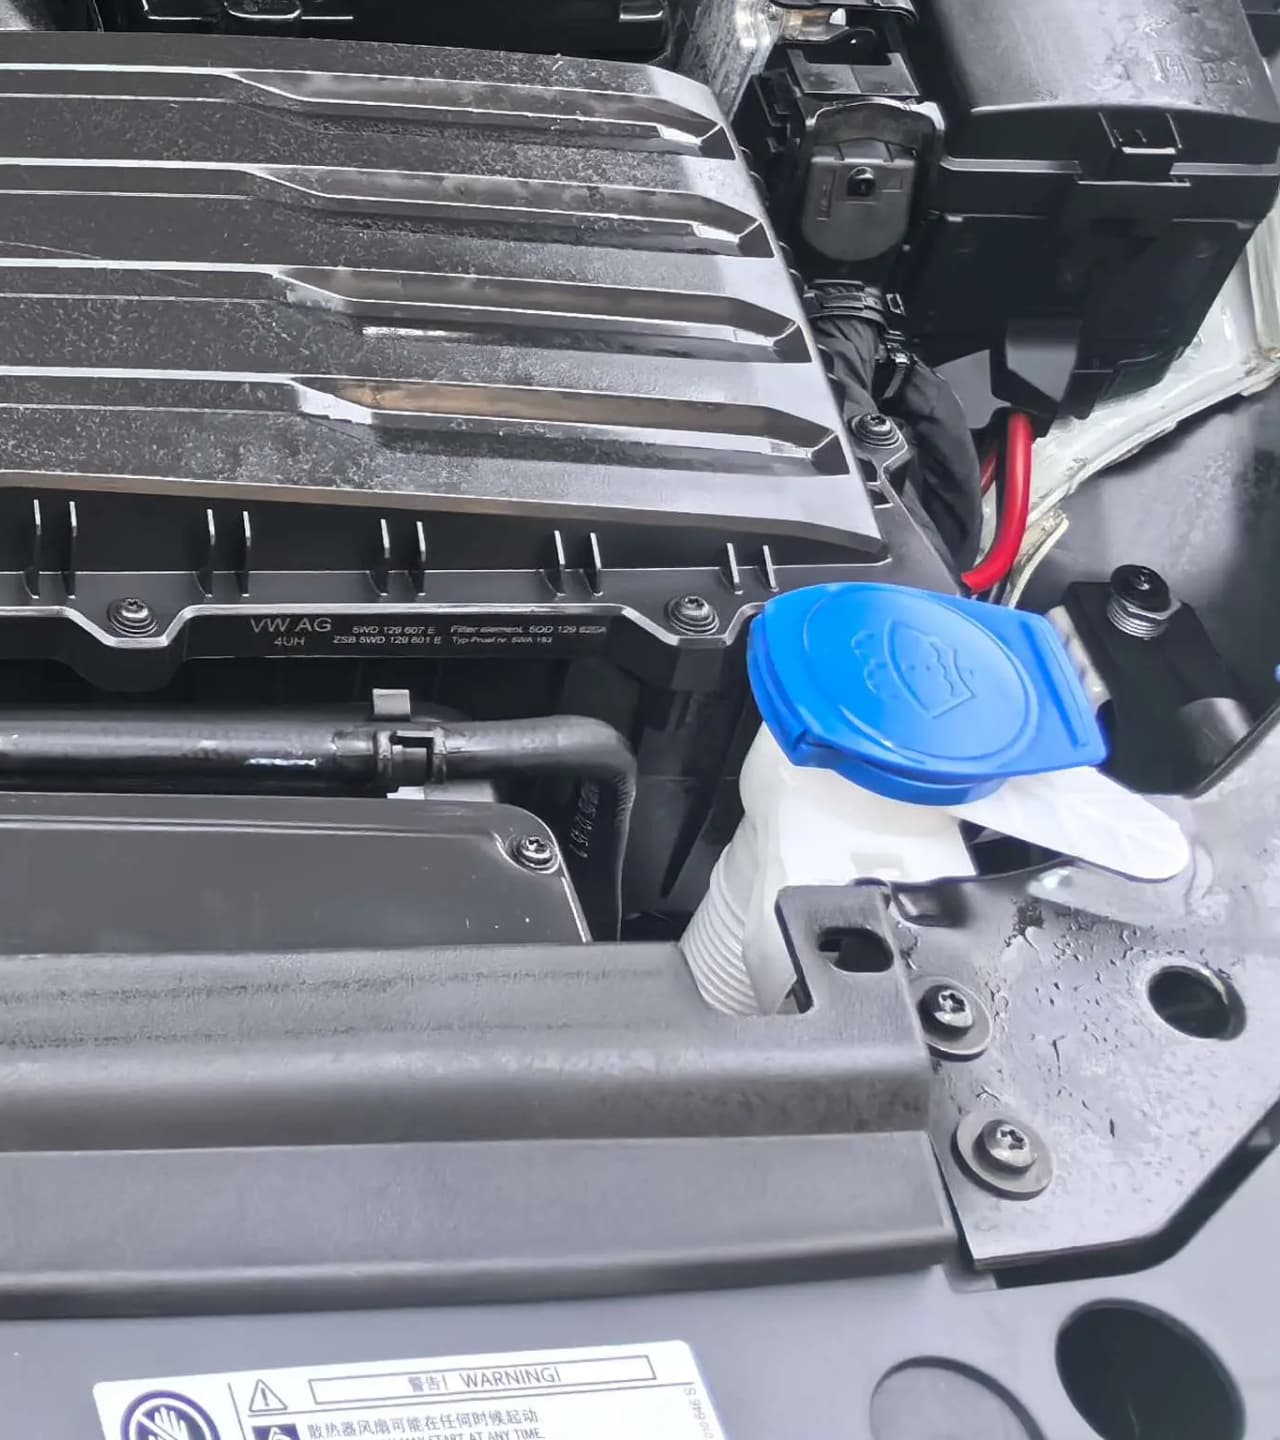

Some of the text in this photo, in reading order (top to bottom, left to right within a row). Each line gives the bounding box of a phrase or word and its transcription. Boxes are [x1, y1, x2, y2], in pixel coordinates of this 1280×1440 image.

[250, 617, 333, 633] VW AG
[460, 1366, 563, 1389] WARNING!
